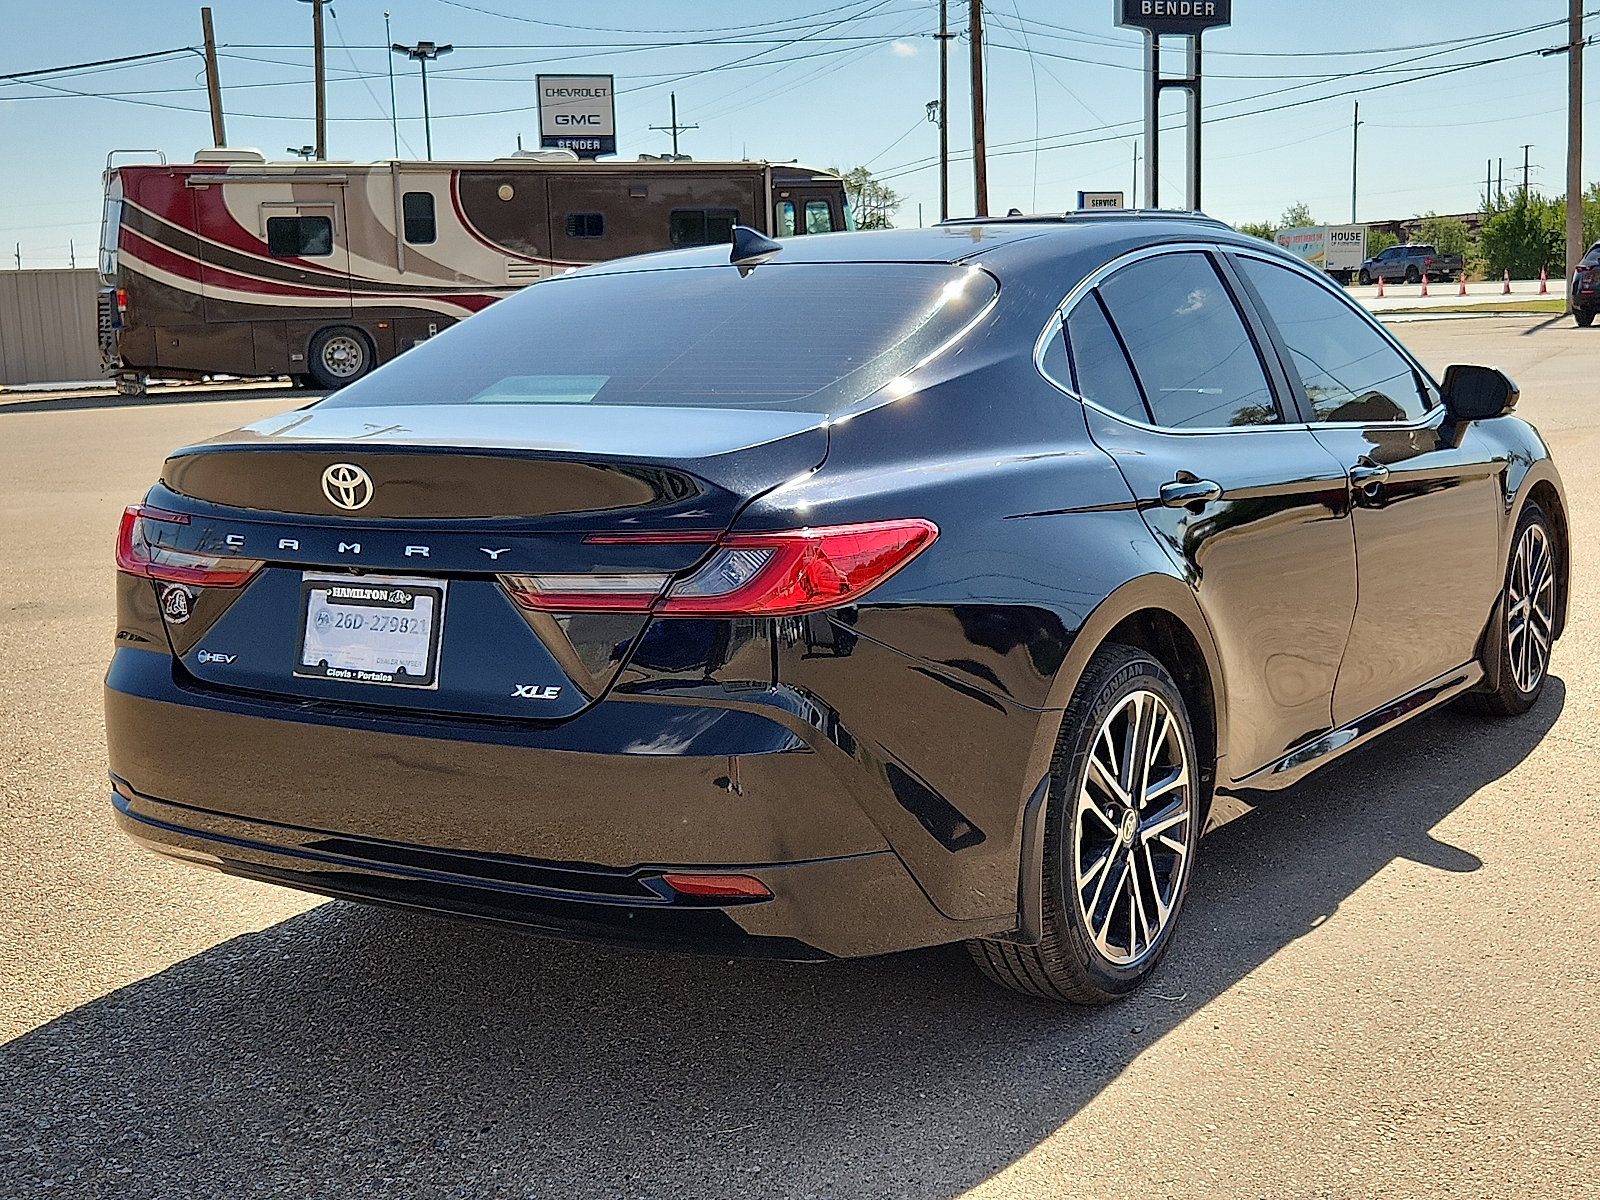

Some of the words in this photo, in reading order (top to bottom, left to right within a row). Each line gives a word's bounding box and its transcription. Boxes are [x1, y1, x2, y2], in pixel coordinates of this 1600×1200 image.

[1141, 1, 1215, 16] BENDER
[545, 88, 607, 98] CHEVROLET
[555, 114, 601, 125] GMC
[558, 140, 600, 150] BENDER
[1091, 199, 1117, 208] SERVICE
[1331, 232, 1361, 241] HOUSE
[226, 534, 511, 560] CAMRY
[332, 587, 388, 601] HAMILTON
[335, 612, 430, 635] 26D-279821
[326, 668, 352, 678] Clovis
[357, 671, 393, 682] Portales
[510, 684, 561, 700] XLE
